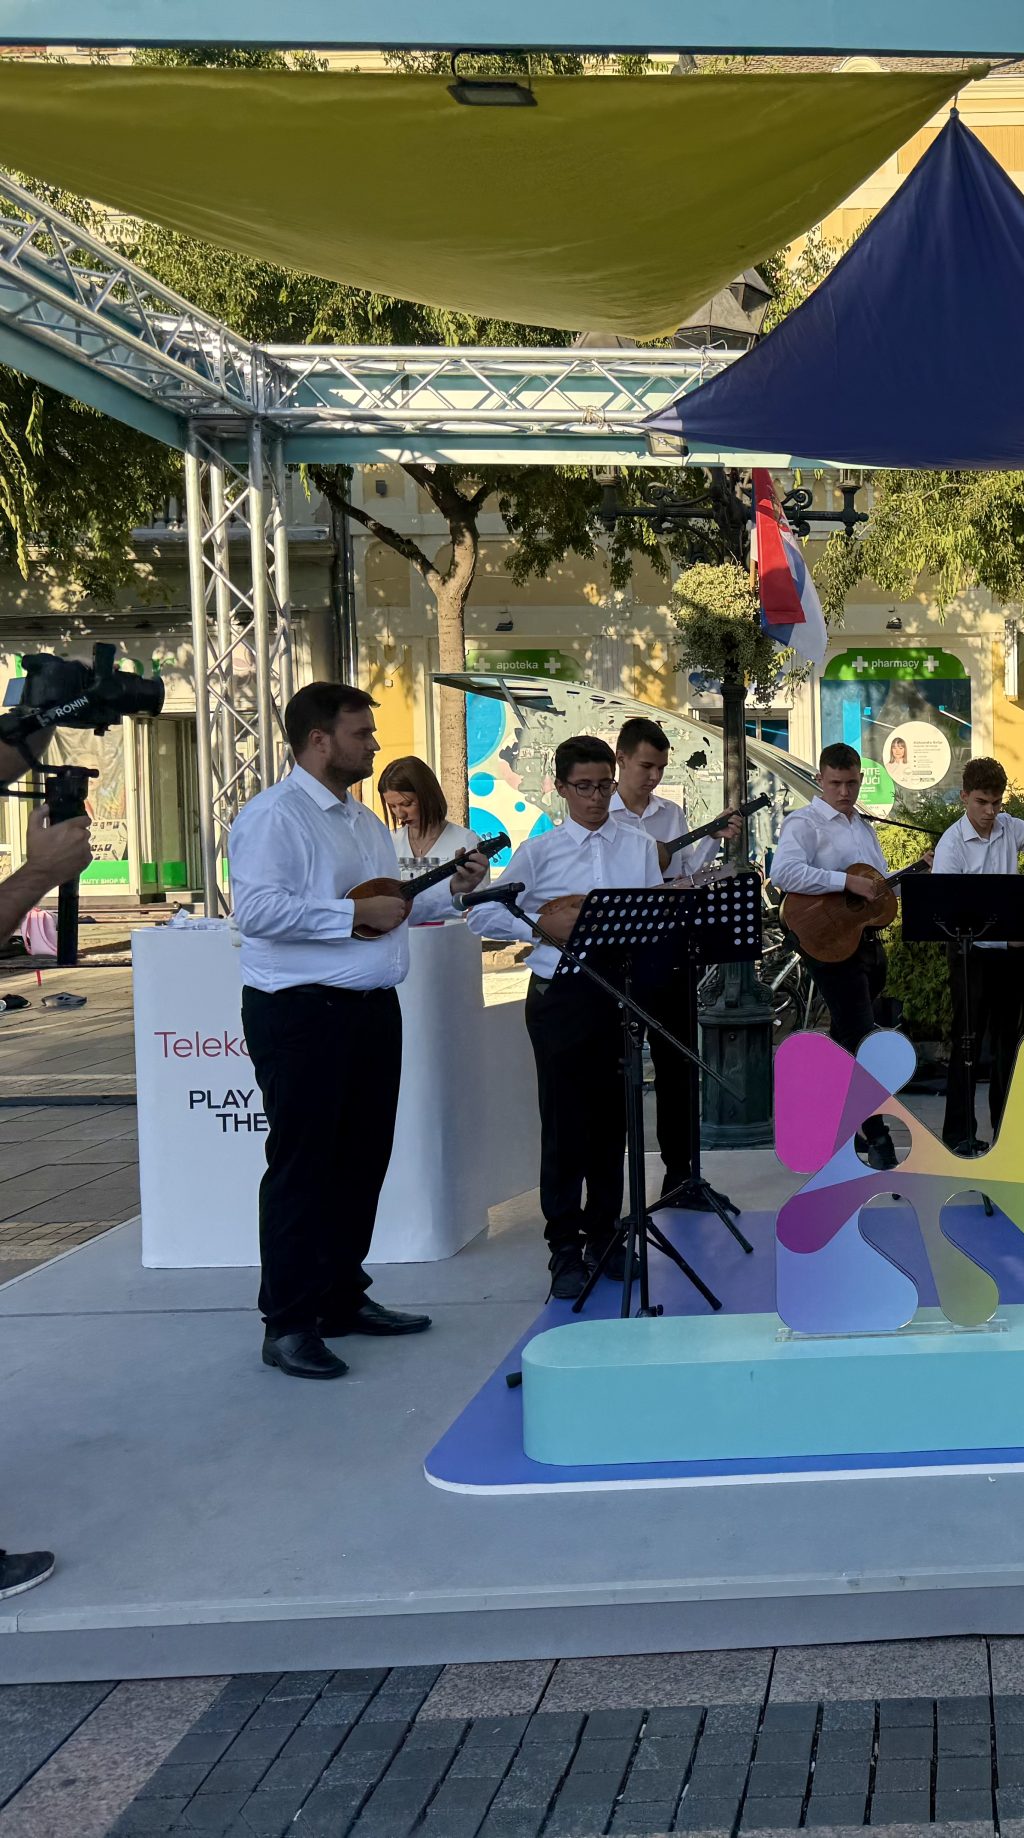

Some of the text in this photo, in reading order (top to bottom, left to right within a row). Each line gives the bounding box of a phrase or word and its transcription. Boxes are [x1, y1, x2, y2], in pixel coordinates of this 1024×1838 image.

[496, 660, 539, 671] apoteka
[871, 659, 920, 670] pharmacy
[55, 696, 89, 718] RONIN
[189, 1089, 255, 1109] PLAY
[216, 1113, 269, 1132] THE
